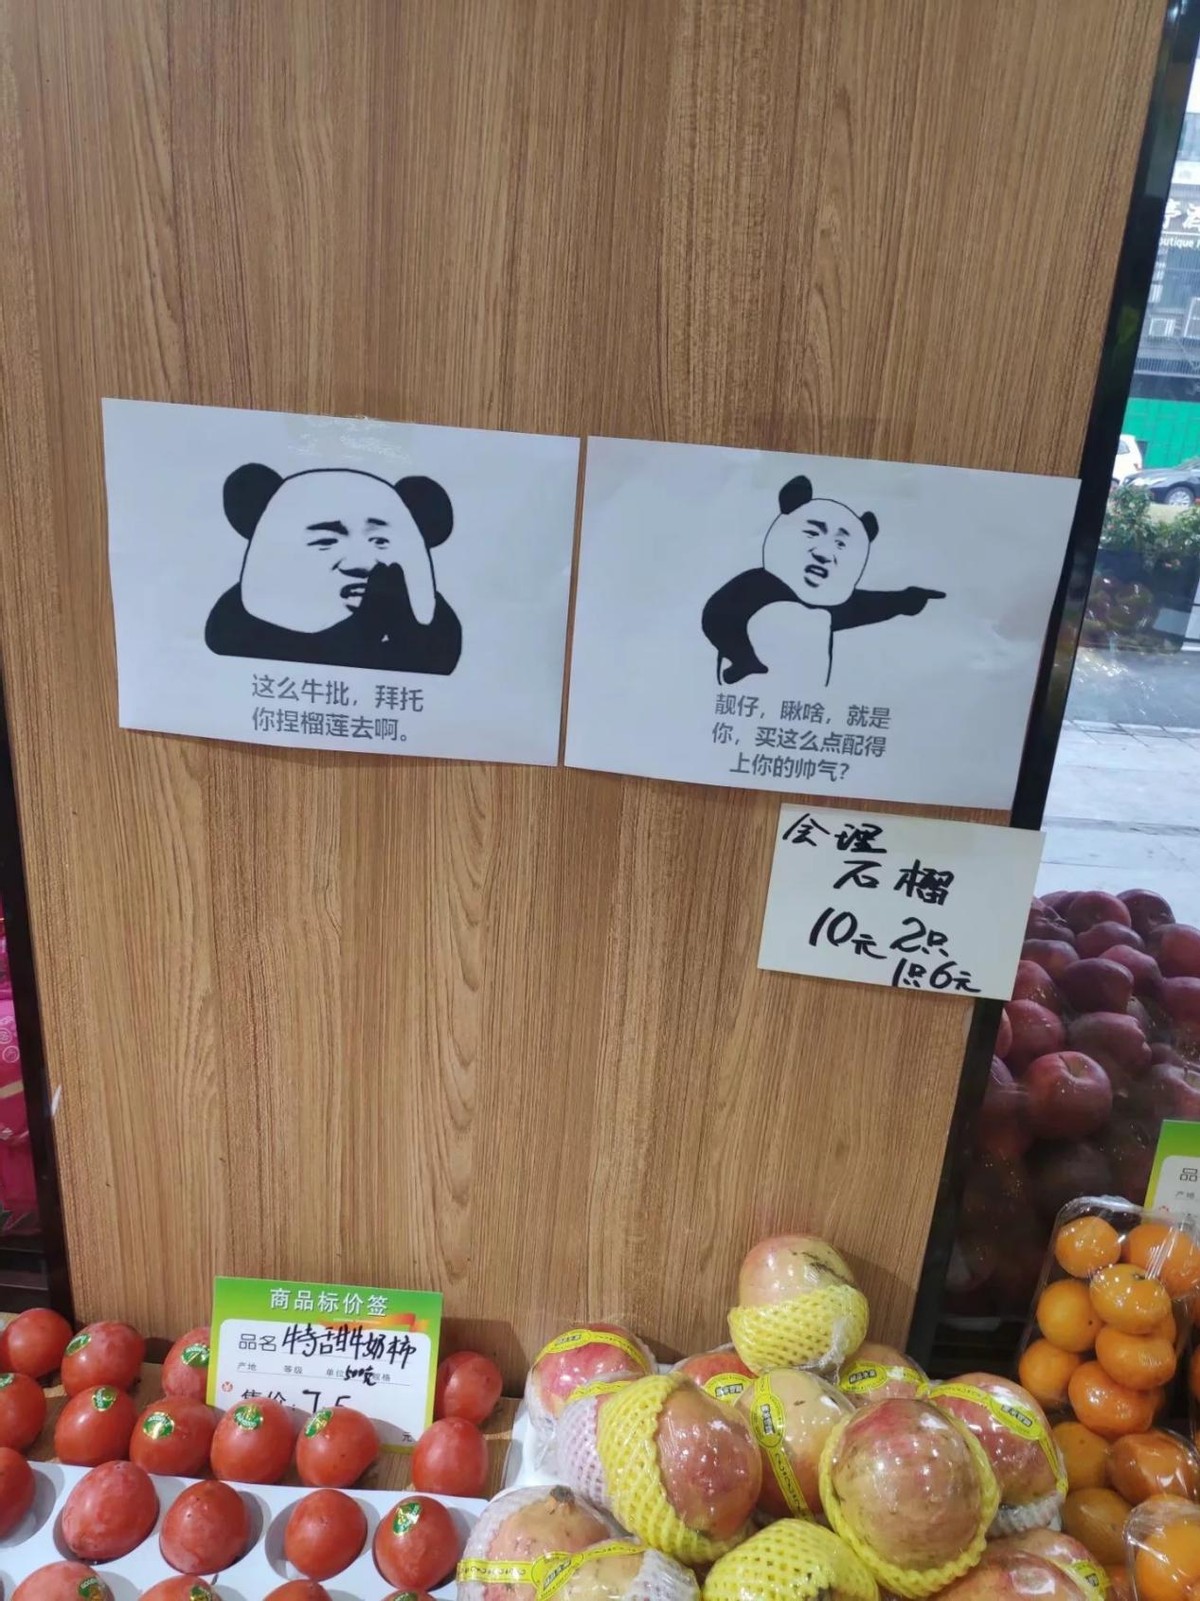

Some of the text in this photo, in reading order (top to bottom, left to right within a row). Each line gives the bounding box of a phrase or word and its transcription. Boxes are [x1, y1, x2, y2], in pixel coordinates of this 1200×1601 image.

[251, 674, 424, 712] 这么牛批，拜托
[715, 693, 892, 730] 靓仔，瞅啥，就是
[251, 706, 408, 742] 你捏榴莲去啊。
[712, 721, 887, 758] 你，买这么点配得
[833, 859, 955, 905] 石榴
[270, 1287, 389, 1317] 商品标价签
[238, 1333, 277, 1352] 品名
